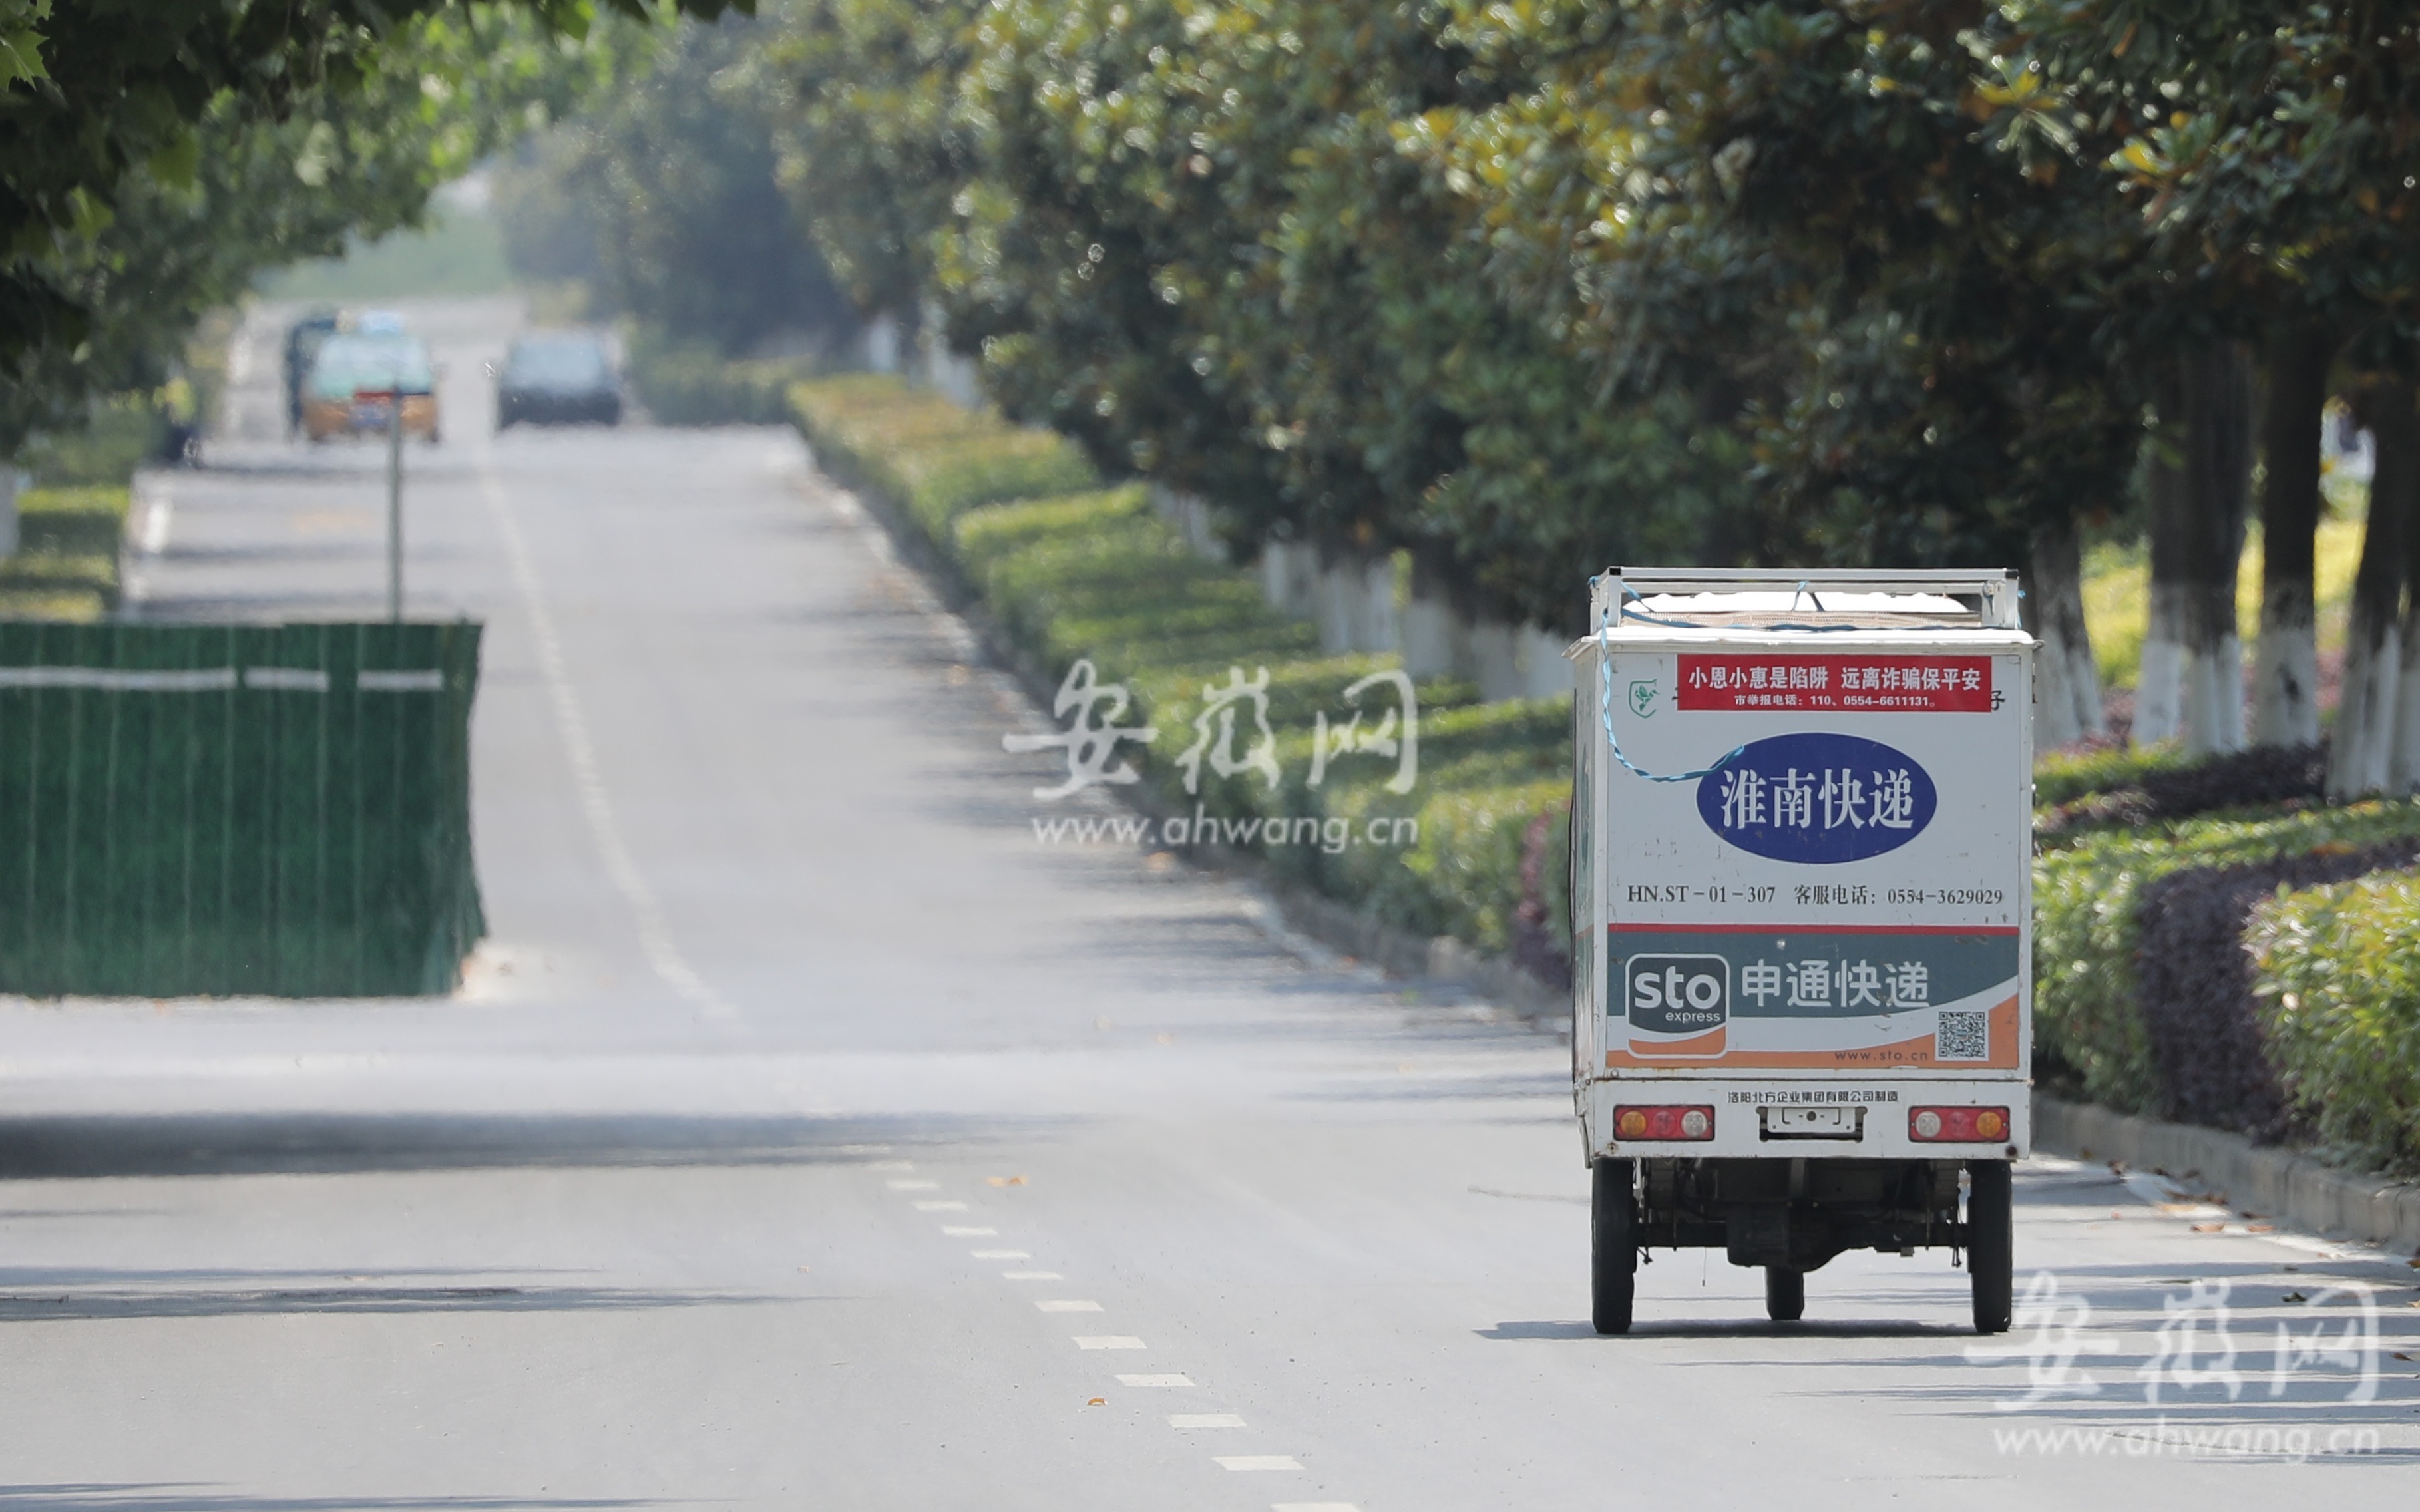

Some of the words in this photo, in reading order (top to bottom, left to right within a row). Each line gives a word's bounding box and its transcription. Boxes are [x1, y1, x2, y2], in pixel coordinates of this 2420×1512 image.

[1689, 666, 1829, 689] 小恩小惠是陷阱
[1841, 667, 1981, 691] 远离诈骗保平安
[1720, 767, 1914, 829] 淮南快递
[1635, 966, 1721, 1010] sto
[1741, 958, 1930, 1008] 申通快递
[1665, 1012, 1721, 1024] express
[1834, 1050, 1928, 1061] www.sto.cn
[1728, 1091, 1899, 1103] 洛阳北方企业集团有限公司制造
